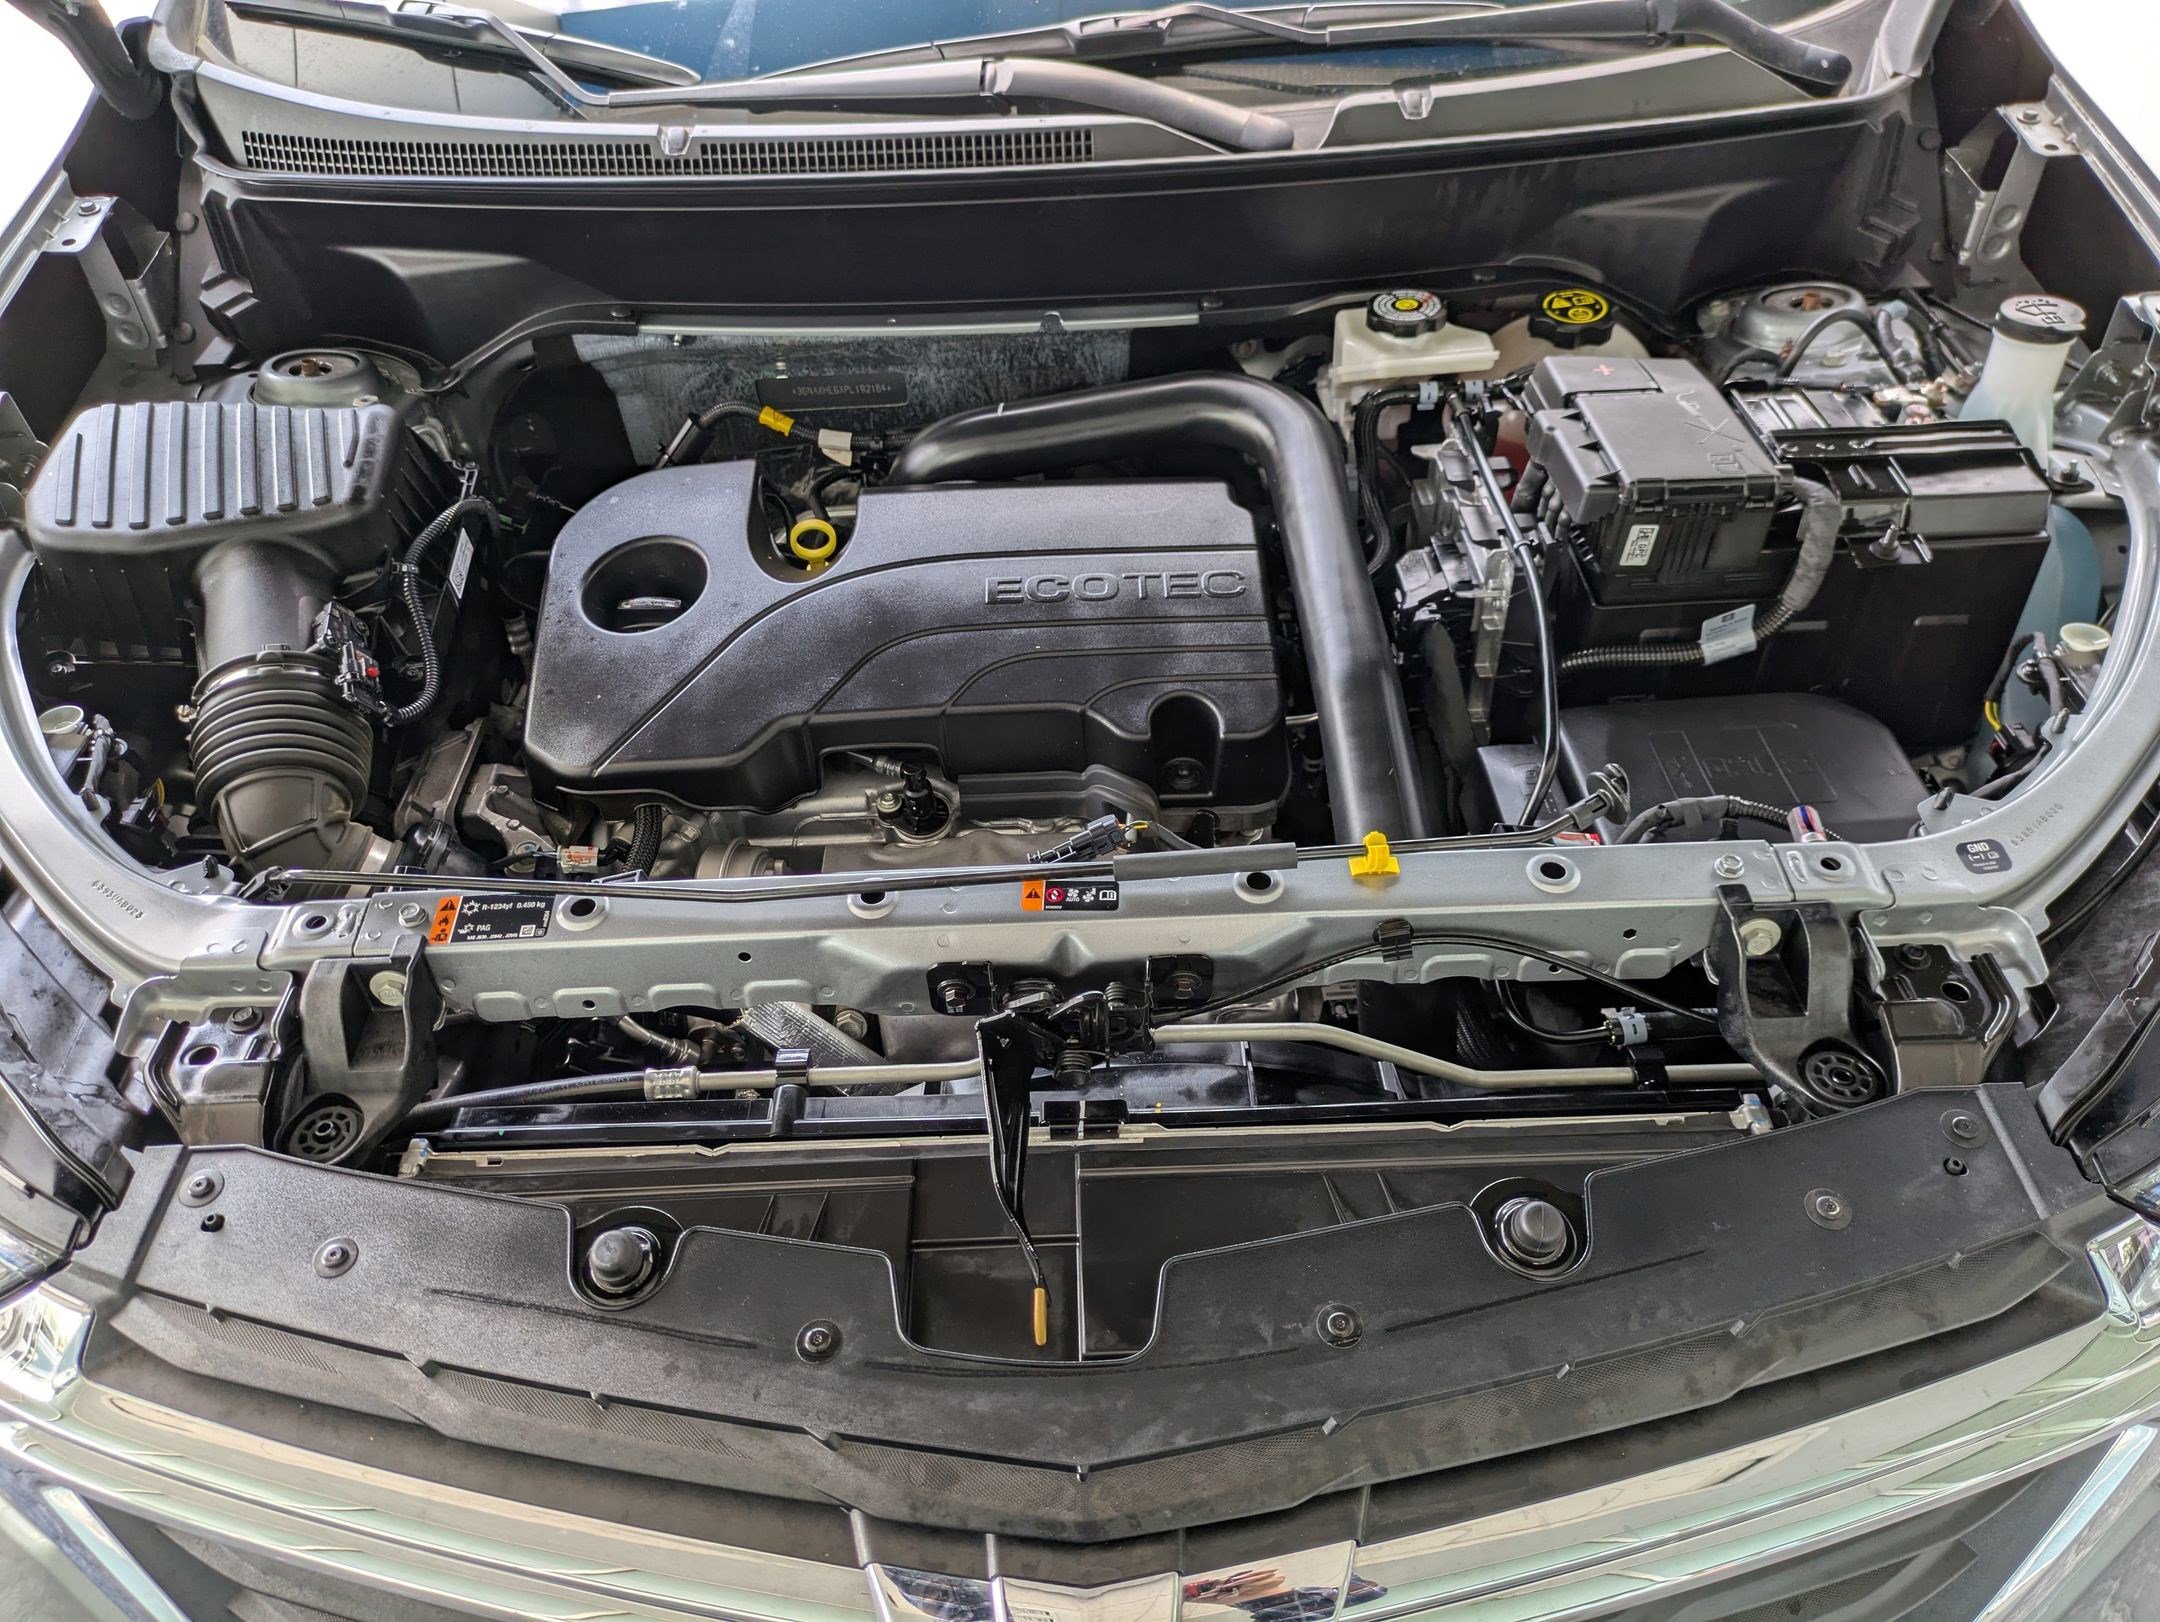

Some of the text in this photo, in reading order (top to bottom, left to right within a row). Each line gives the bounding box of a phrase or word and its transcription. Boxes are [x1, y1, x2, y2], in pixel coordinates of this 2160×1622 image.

[985, 570, 1248, 604] ECOTEC
[1967, 842, 1990, 853] GND
[481, 901, 546, 911] R-1234yf 0.450 kg
[476, 924, 491, 932] PAG
